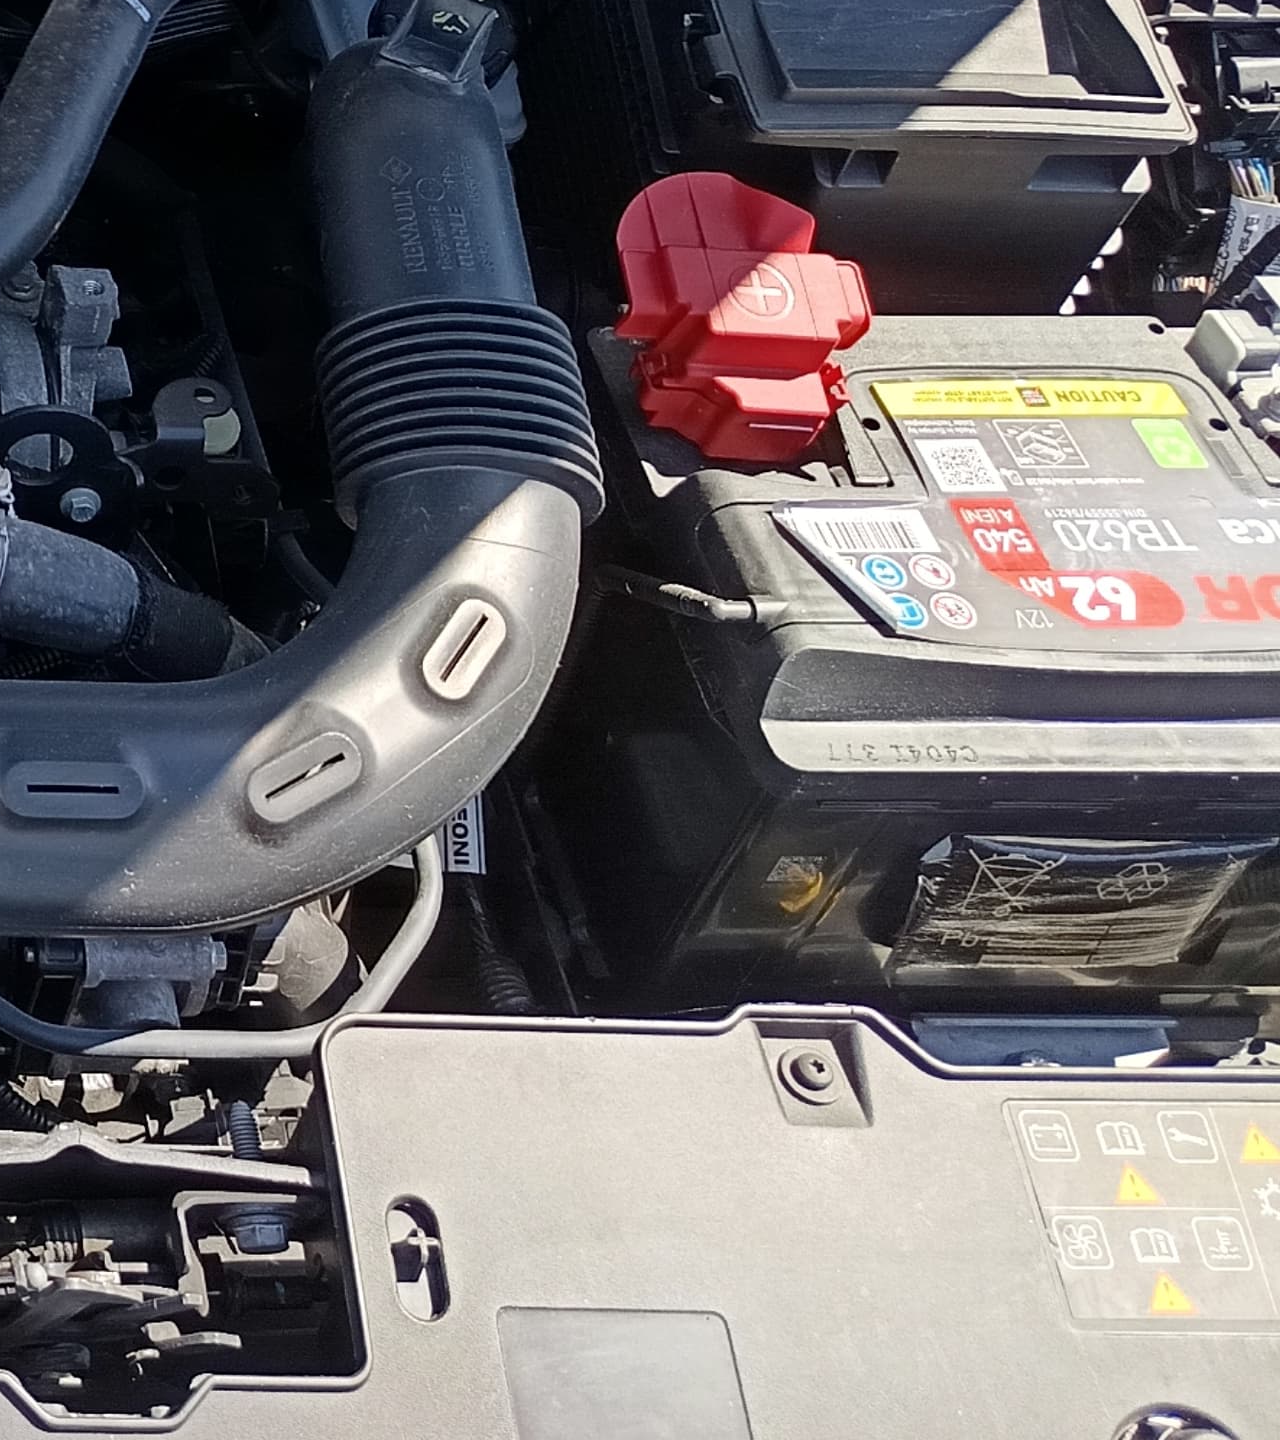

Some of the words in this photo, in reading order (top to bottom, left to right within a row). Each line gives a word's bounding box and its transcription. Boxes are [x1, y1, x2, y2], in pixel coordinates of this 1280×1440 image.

[1054, 390, 1142, 402] CAUTION
[973, 527, 1034, 553] 540
[1052, 518, 1200, 552] TB620
[1019, 576, 1055, 597] Ah
[1058, 576, 1137, 621] 62
[1015, 610, 1054, 628] 12V
